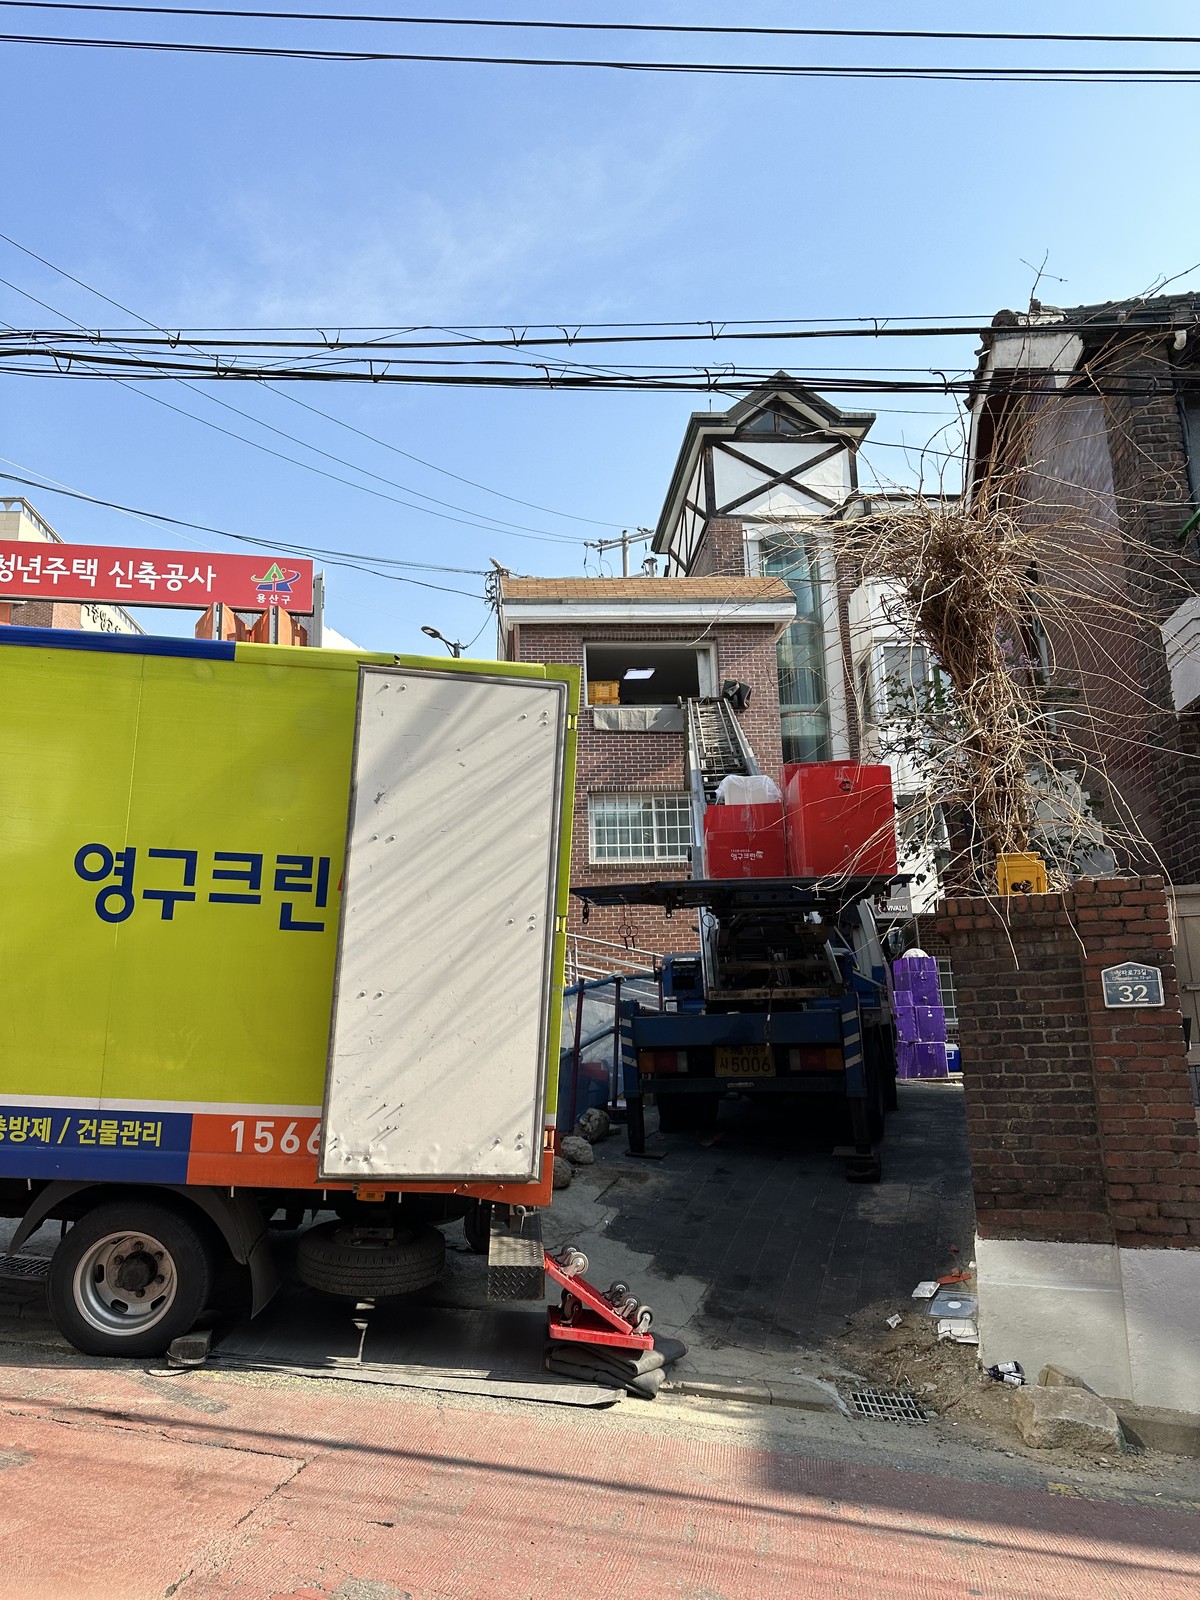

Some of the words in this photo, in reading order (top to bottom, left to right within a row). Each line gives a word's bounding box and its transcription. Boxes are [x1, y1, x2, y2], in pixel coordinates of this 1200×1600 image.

[0, 553, 98, 587] 청년주택
[108, 560, 217, 592] 신축공사
[256, 593, 291, 605] 용산구
[730, 852, 756, 861] 영구크린
[74, 843, 331, 932] 영구크린
[1118, 984, 1150, 1003] 32
[76, 1119, 162, 1147] 건물관리
[230, 1120, 322, 1155] 1566
